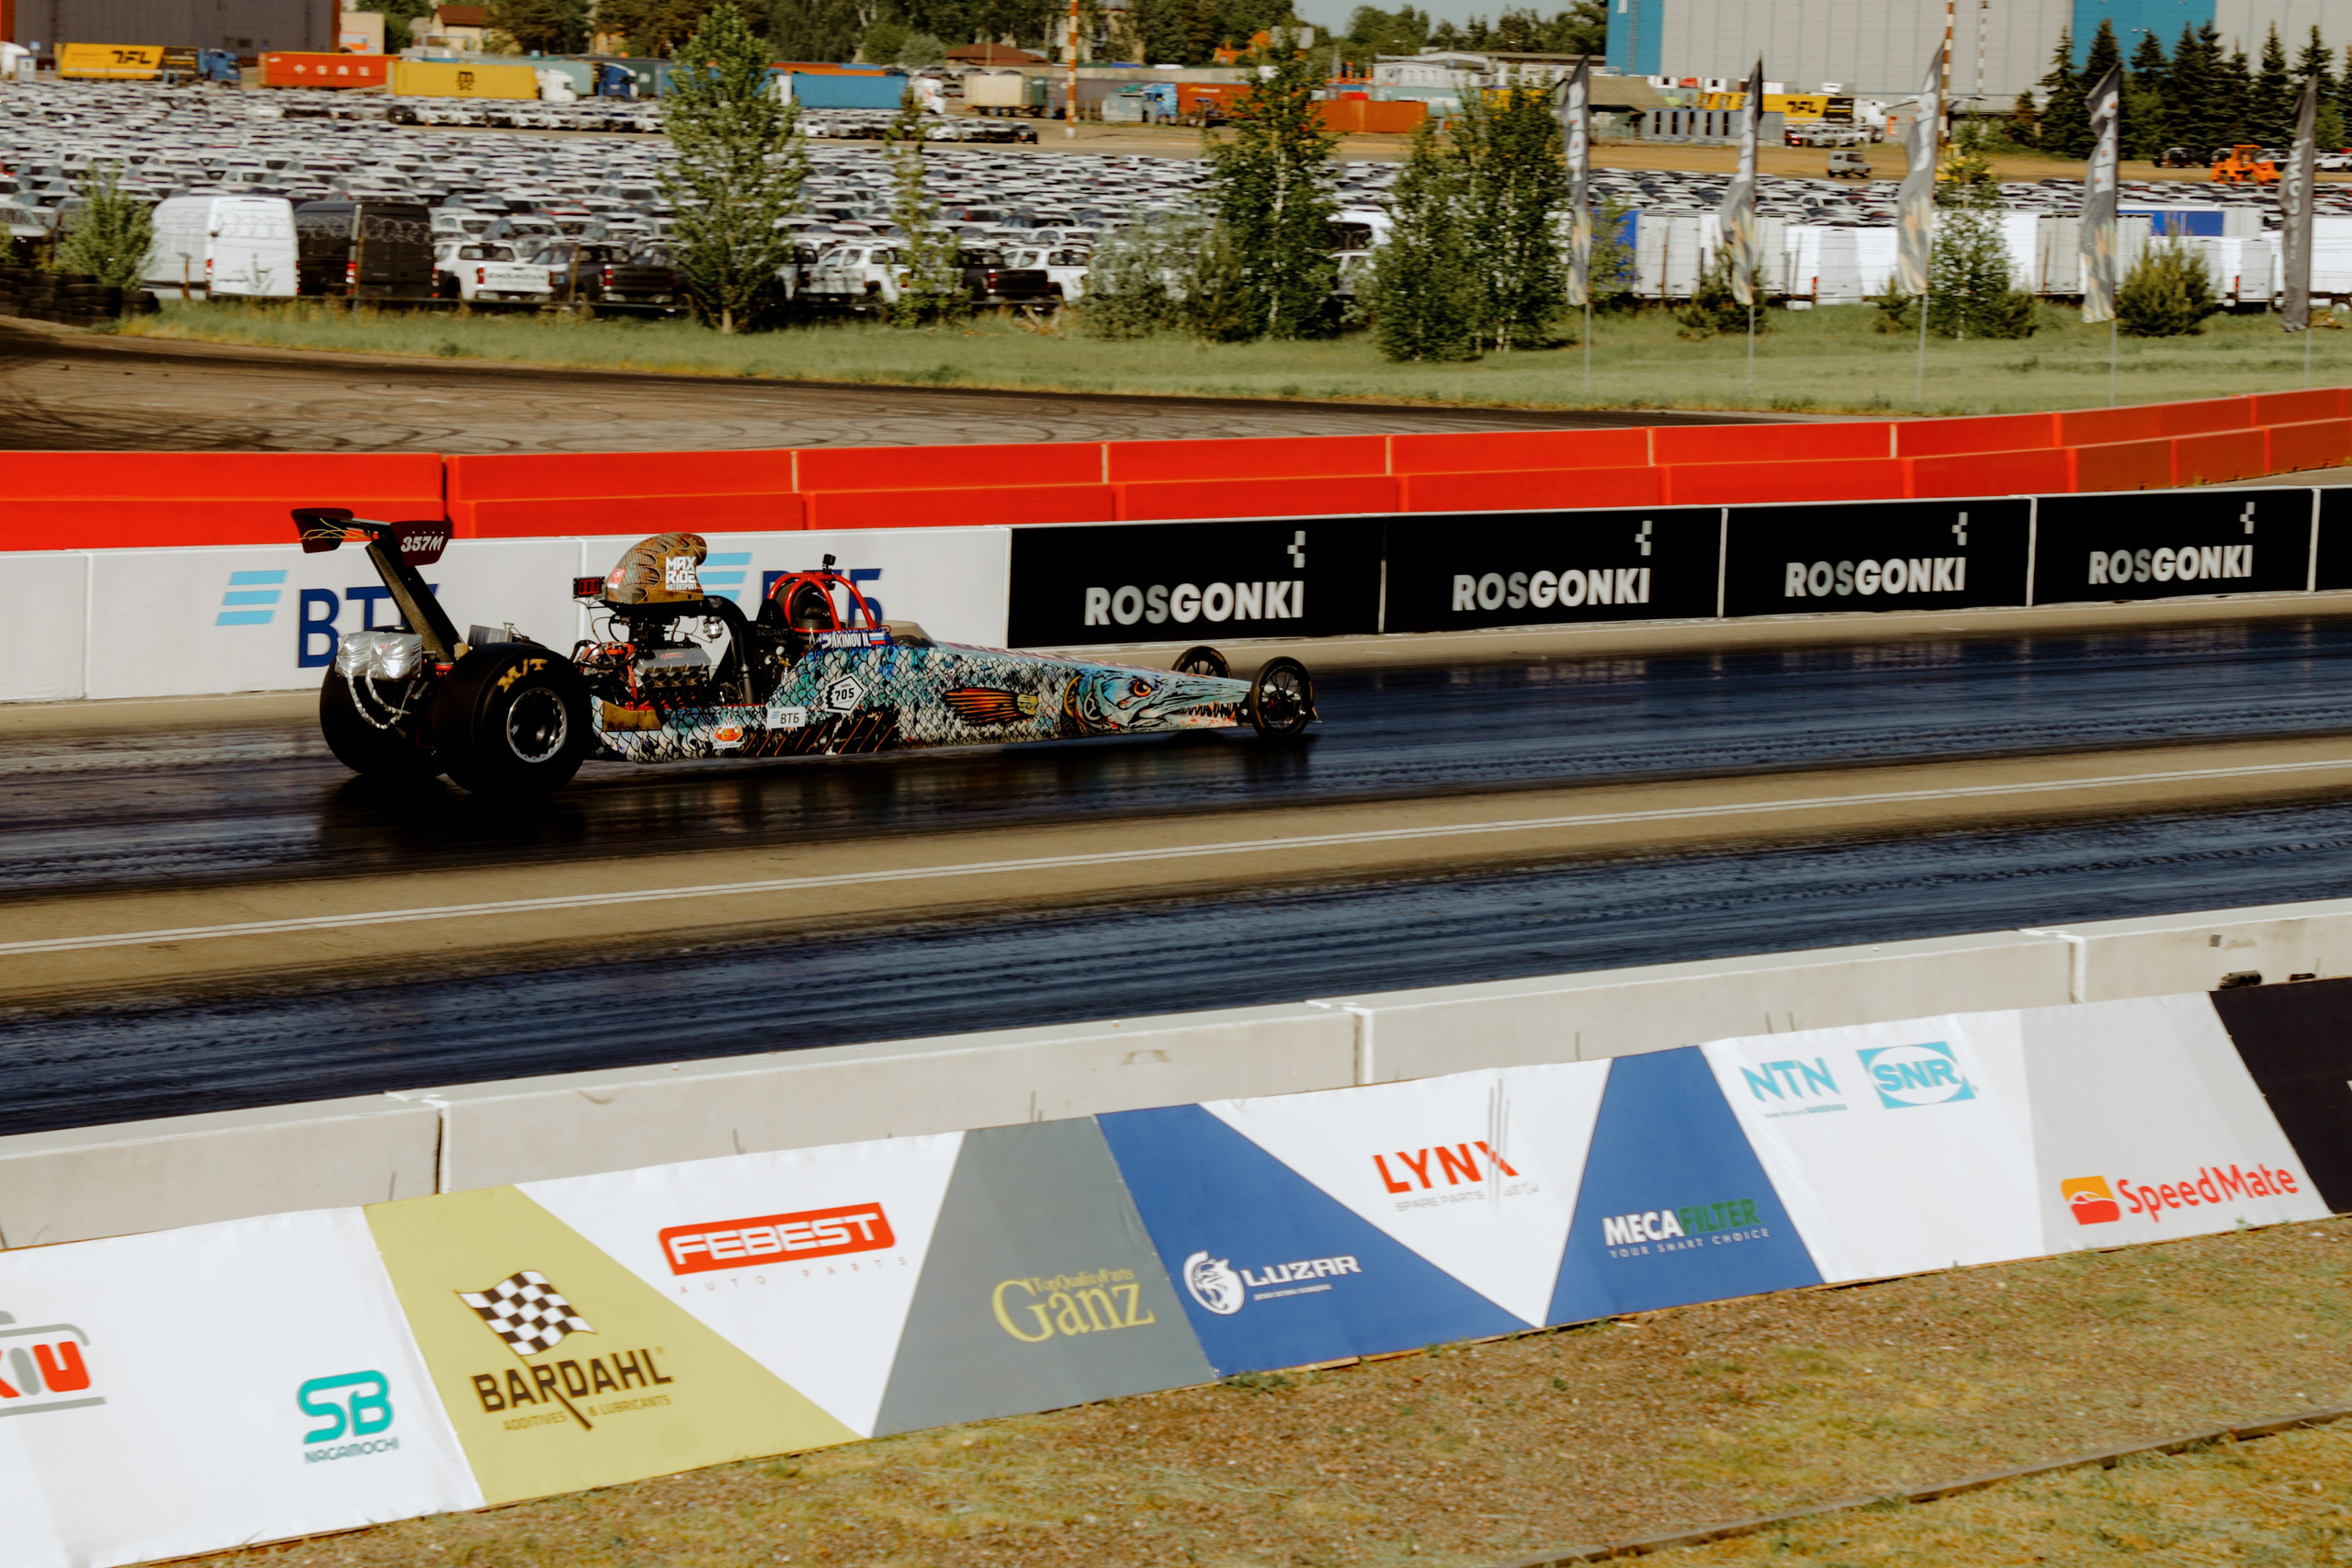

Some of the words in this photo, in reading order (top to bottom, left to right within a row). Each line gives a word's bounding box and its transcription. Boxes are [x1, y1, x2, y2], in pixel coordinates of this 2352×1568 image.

[401, 536, 444, 552] 357M
[665, 556, 697, 570] MAX
[1784, 557, 1966, 597] ROSGONKI
[2088, 545, 2253, 584] ROSGONKI
[665, 582, 697, 591] MOTORSPORT
[1084, 581, 1304, 626] ROSGONKI
[1452, 568, 1650, 611] ROSGONKI
[298, 583, 439, 668] ВТ
[831, 631, 862, 649] AKIMOV
[497, 659, 548, 693] M/T
[835, 687, 854, 701] 705
[780, 713, 799, 724] ВТБ
[1739, 1057, 1841, 1102] NTN
[1872, 1059, 1962, 1092] SNR
[2117, 1163, 2299, 1224] SpeedMate
[668, 1213, 879, 1265] FEBEST
[1609, 1246, 1650, 1258] YOUR
[1657, 1238, 1704, 1253] SMART
[1712, 1228, 1771, 1246] CHOICE
[1240, 1255, 1363, 1287] LUZAR
[991, 1279, 1157, 1343] Ganz
[470, 1348, 673, 1414] BARDAHL
[297, 1370, 393, 1445] SB
[304, 1437, 400, 1464] NAGAMOCHI
